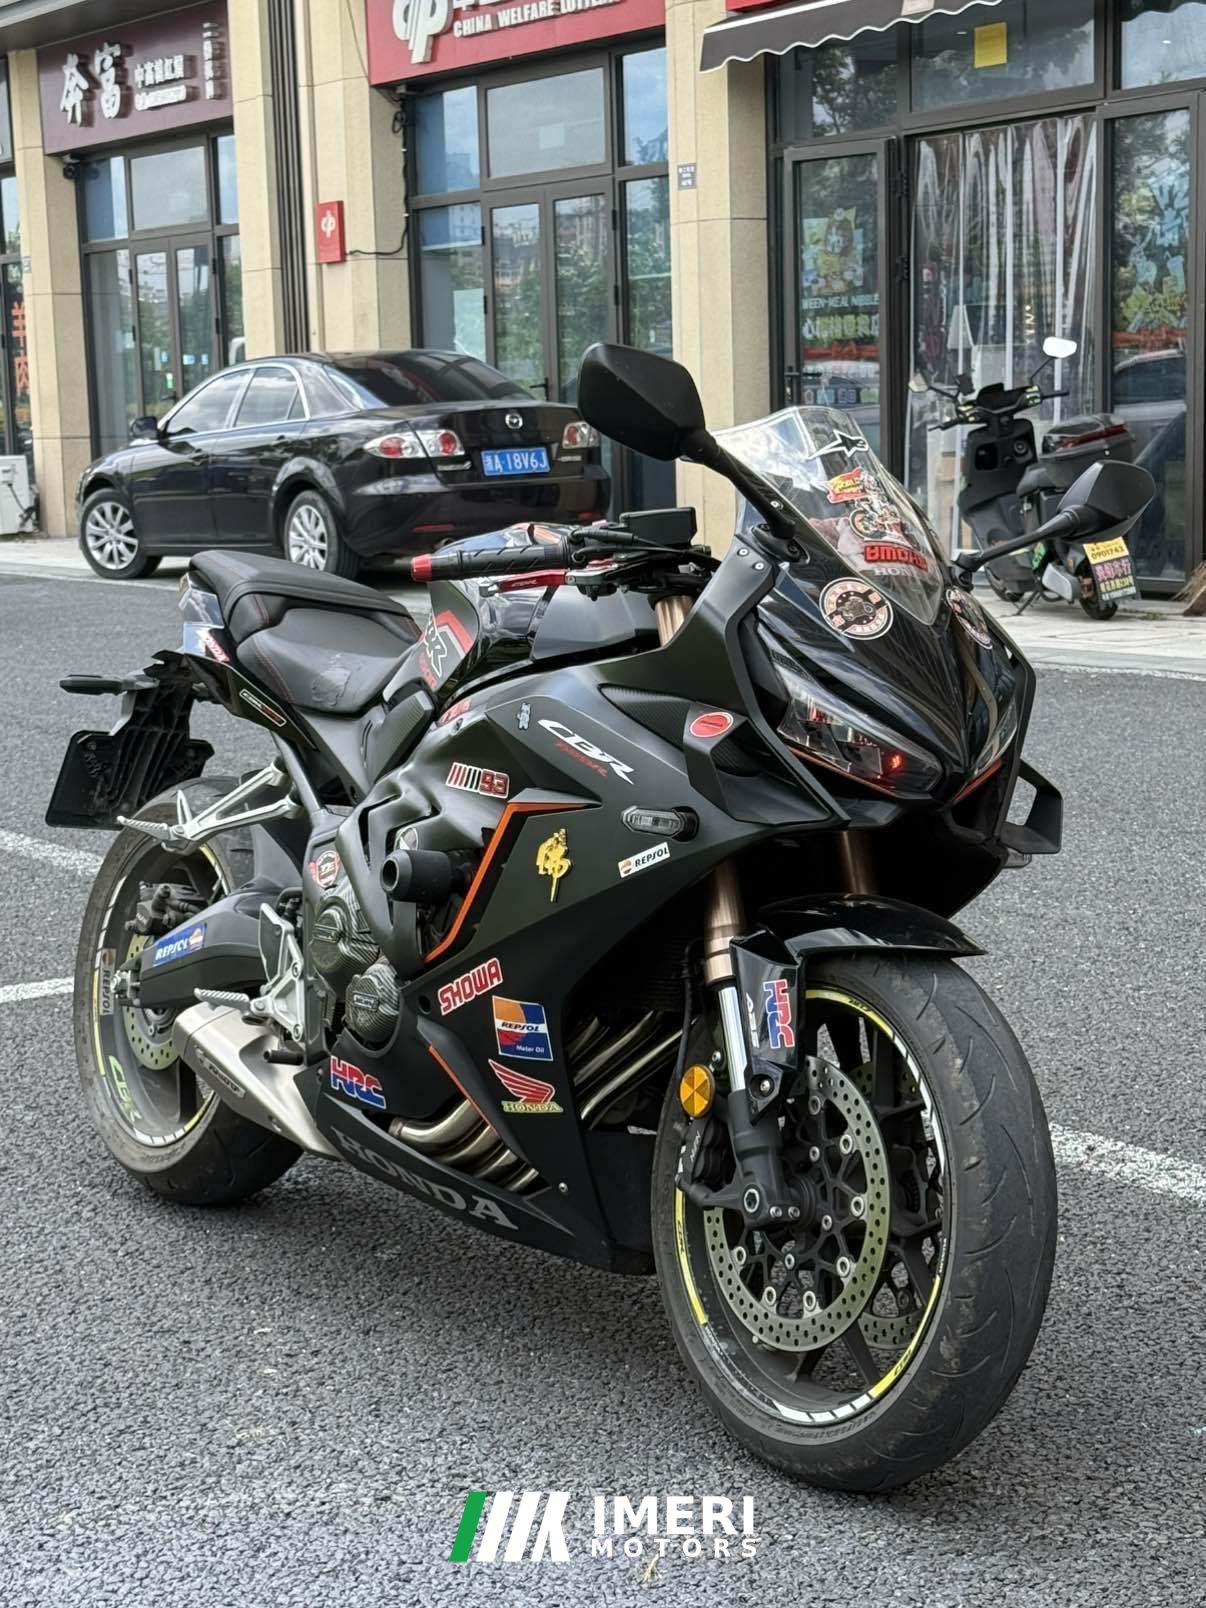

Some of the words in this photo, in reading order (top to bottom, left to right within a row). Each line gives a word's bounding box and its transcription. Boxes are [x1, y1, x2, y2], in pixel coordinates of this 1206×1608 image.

[453, 13, 492, 38] CHINA
[498, 1, 556, 27] WELFARE
[538, 719, 635, 785] CBR
[479, 769, 510, 799] 93
[634, 847, 669, 868] REPSOL
[438, 957, 503, 1016] SHOWA
[501, 1021, 540, 1032] REPSOL
[763, 979, 795, 1048] HRC
[329, 1055, 387, 1110] HRC
[504, 1102, 561, 1112] HONDA
[330, 1126, 519, 1231] HONDA
